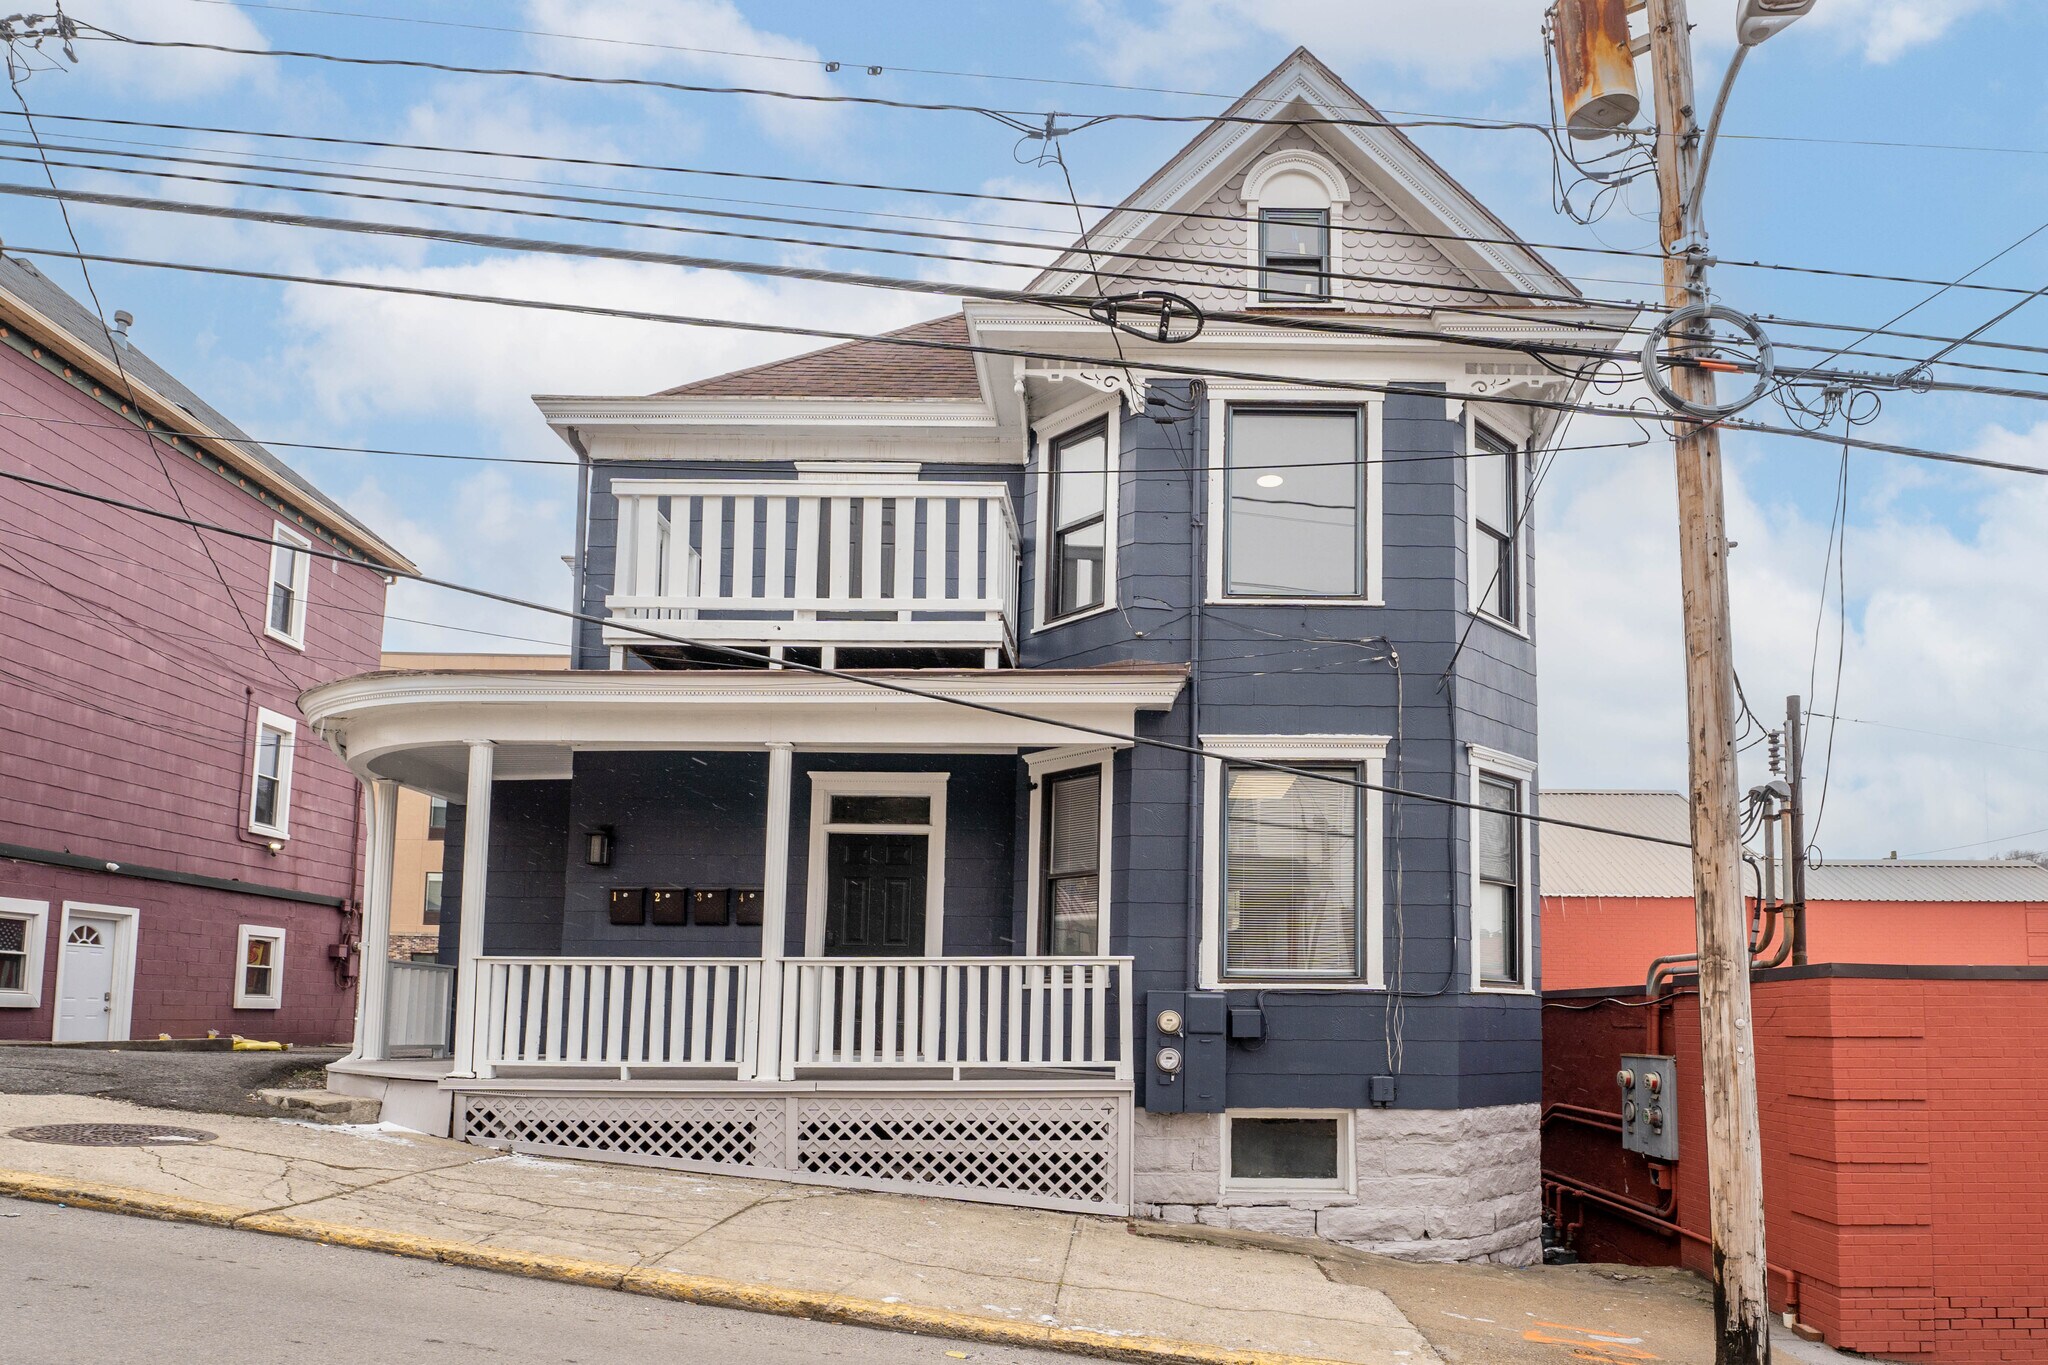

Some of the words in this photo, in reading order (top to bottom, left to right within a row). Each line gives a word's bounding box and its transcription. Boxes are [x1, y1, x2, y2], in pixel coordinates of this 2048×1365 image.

[654, 892, 661, 902] 2
[696, 892, 702, 902] 3
[739, 892, 744, 902] 4
